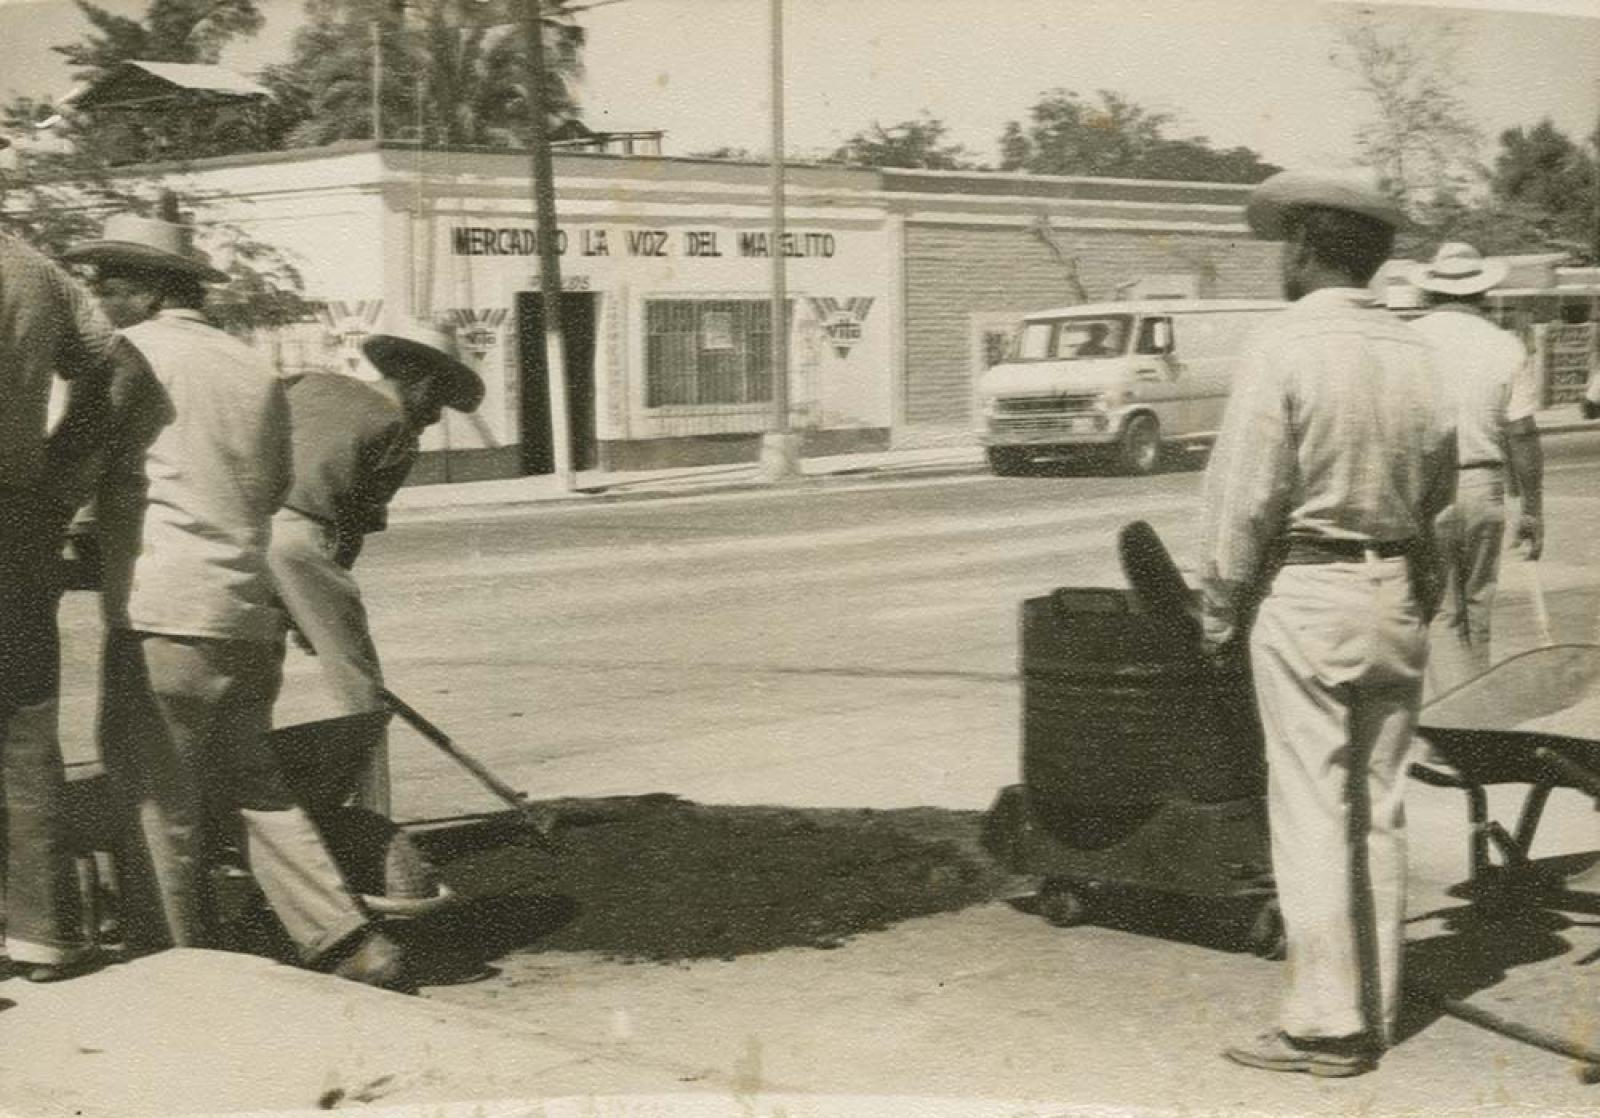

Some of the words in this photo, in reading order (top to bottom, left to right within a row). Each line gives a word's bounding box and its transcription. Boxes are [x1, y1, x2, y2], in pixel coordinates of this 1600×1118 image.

[454, 227, 568, 256] MERCADO
[582, 229, 609, 256] LA
[627, 230, 668, 257] VOZ
[687, 231, 722, 257] DEL
